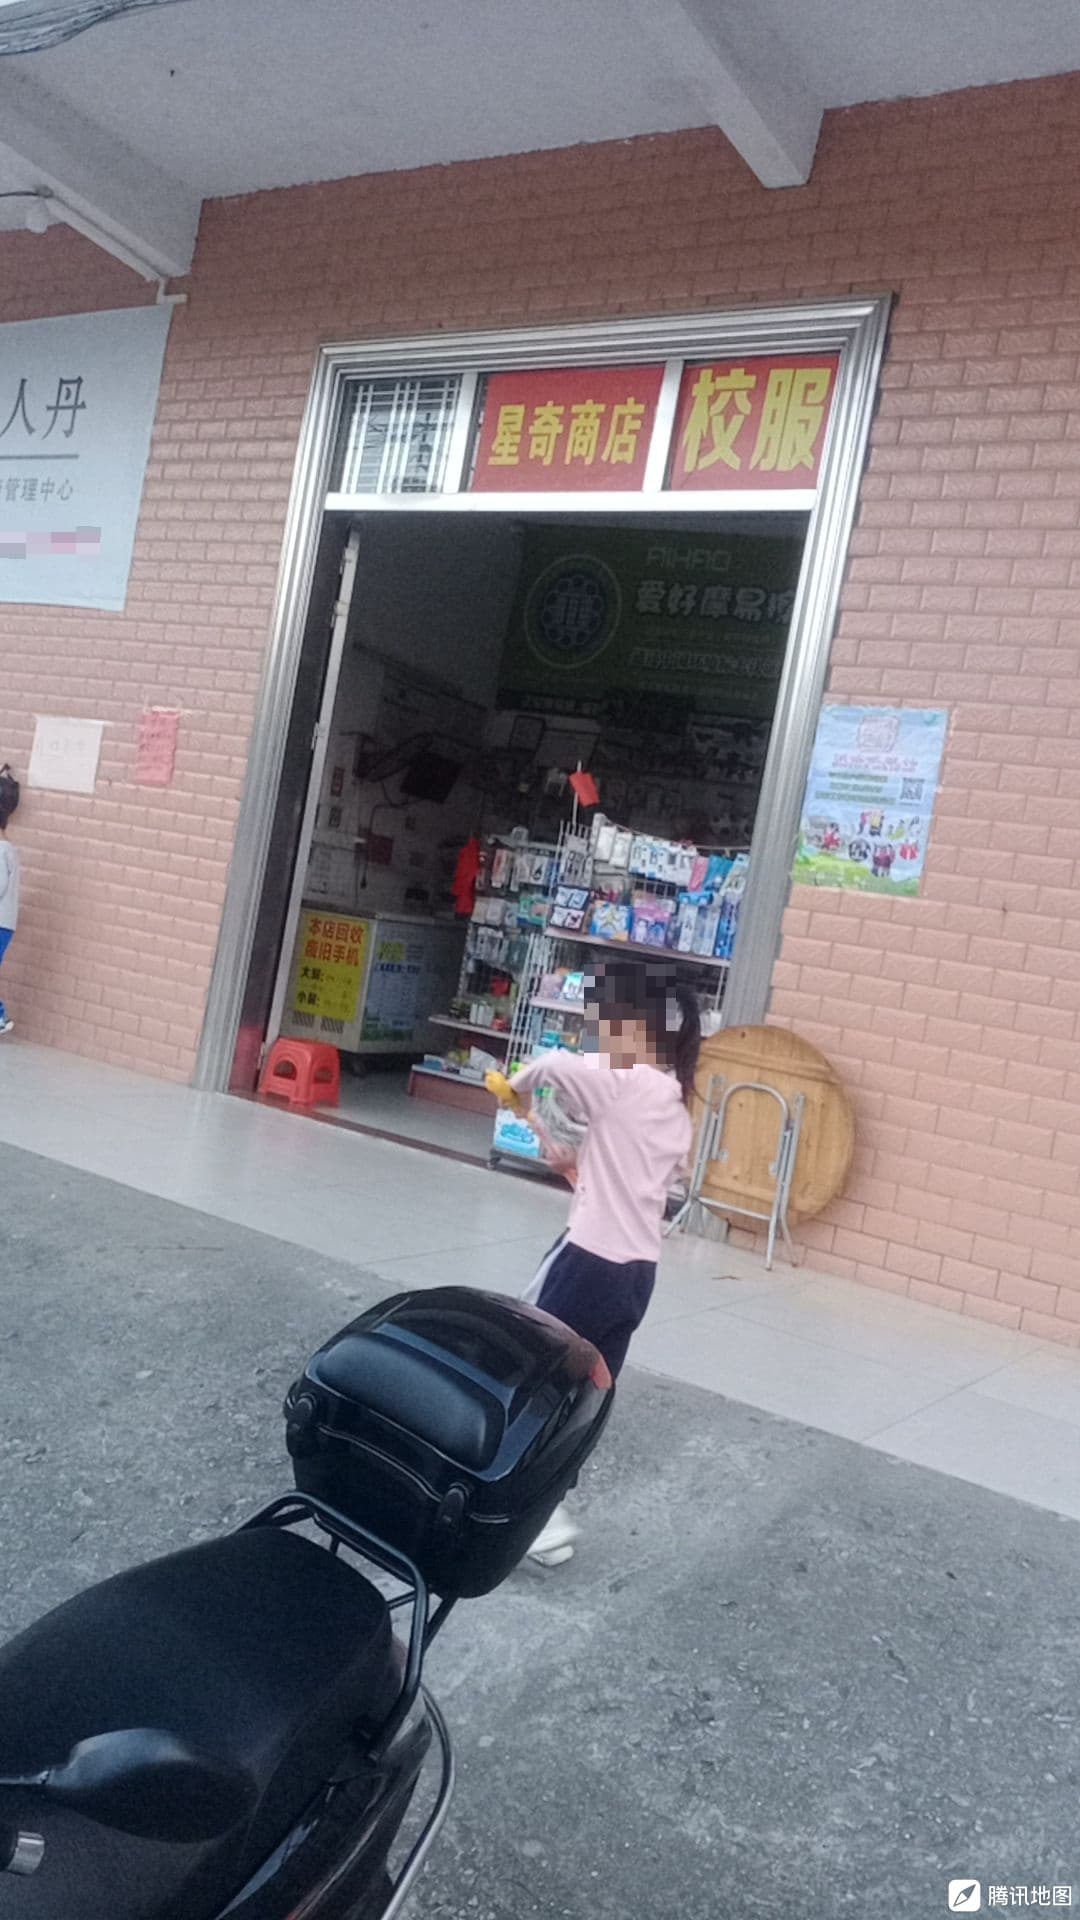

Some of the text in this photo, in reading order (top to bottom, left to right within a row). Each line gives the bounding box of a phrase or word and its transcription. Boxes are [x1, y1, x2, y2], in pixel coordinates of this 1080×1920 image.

[487, 396, 645, 466] 星奇商店
[682, 367, 832, 473] 校服
[309, 918, 364, 944] 本店回收
